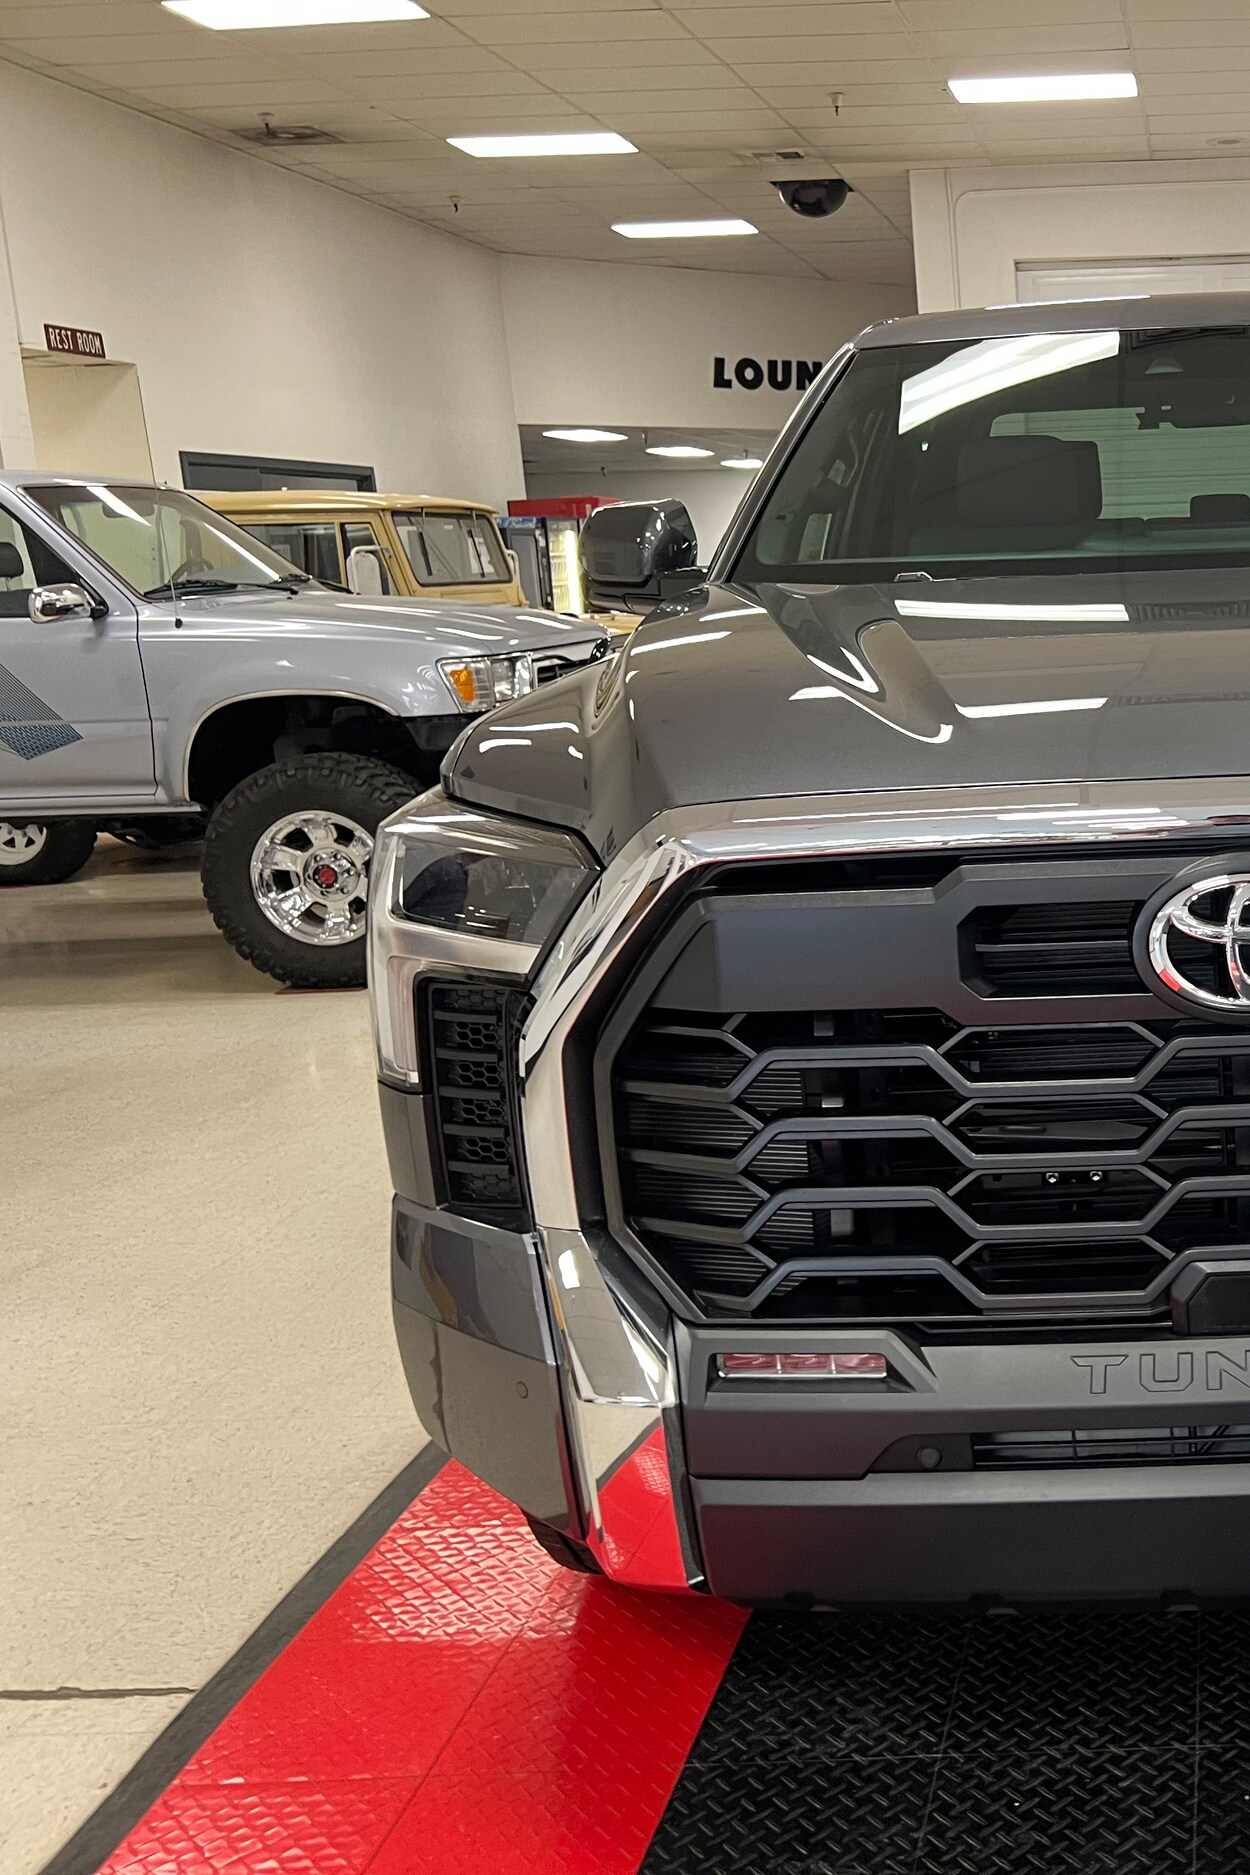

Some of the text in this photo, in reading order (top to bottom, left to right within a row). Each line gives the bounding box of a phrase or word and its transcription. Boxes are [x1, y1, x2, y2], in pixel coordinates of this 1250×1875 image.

[48, 327, 102, 355] REST ROOM
[713, 357, 823, 391] LOUN
